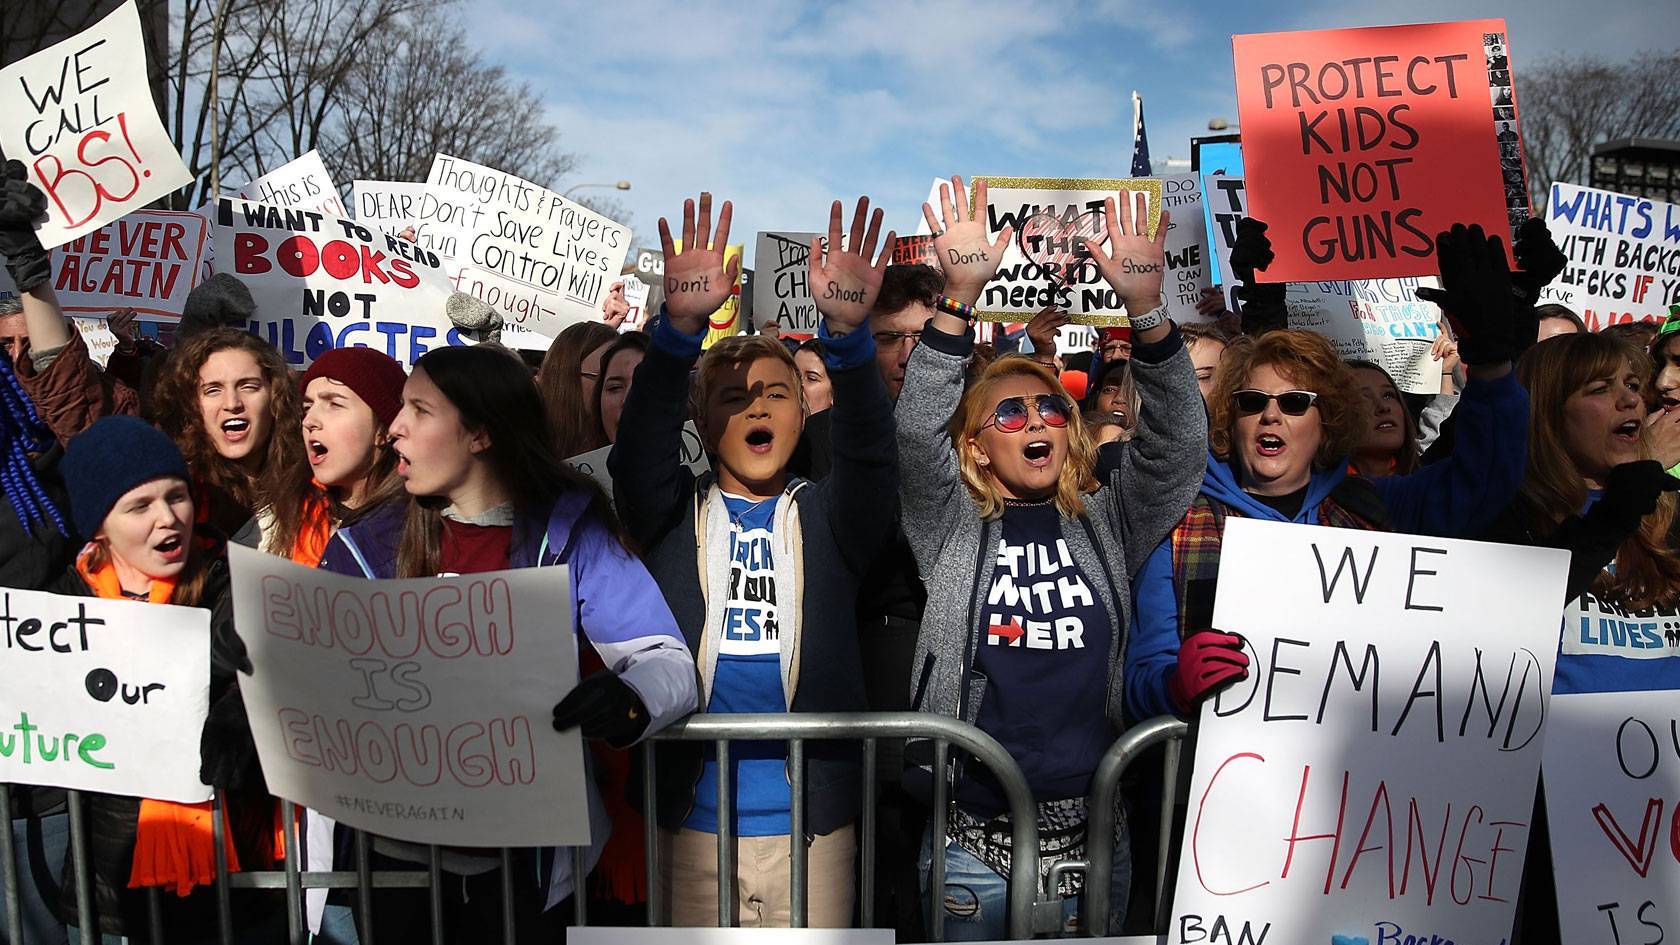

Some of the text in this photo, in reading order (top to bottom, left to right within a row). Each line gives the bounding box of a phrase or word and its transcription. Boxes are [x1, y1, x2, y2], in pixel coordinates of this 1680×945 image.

[20, 38, 110, 114] WE
[1261, 54, 1468, 108] PROTECT
[25, 94, 114, 156] CALL
[1299, 104, 1419, 155] KIDS
[33, 112, 151, 229] BS!
[261, 174, 321, 206] this is
[1166, 179, 1195, 193] DO
[1318, 157, 1413, 204] NOT
[362, 192, 415, 219] DEAR
[438, 157, 534, 212] Thoughts
[549, 197, 622, 249] Prayers
[987, 200, 1106, 233] WHAT
[1162, 192, 1202, 208] THIS?
[1552, 184, 1653, 239] WHAT'S
[218, 197, 234, 227] I
[241, 202, 323, 233] WANT
[337, 219, 372, 243] TO
[384, 234, 440, 268] READ
[420, 193, 610, 272] Don't Save Lives
[1027, 234, 1093, 259] THE
[1302, 208, 1434, 264] GUNS
[55, 255, 181, 300] AGAIN
[234, 232, 420, 289] BOOKS
[416, 223, 603, 305] Gun Control Will
[948, 248, 990, 266] Don't
[1122, 260, 1162, 275] Shoot
[1165, 244, 1200, 270] WE
[1177, 268, 1202, 282] CAN
[1615, 239, 1680, 277] BACKG
[302, 288, 376, 318] NOT
[668, 275, 710, 294] Don't
[823, 280, 867, 304] Shoot
[1178, 282, 1196, 293] DO
[1632, 274, 1654, 304] IF
[988, 574, 1094, 614] WITH
[1311, 543, 1447, 612] WE
[0, 592, 105, 653] tect
[261, 575, 514, 660] ENOUGH
[988, 613, 1085, 650] HER
[1581, 616, 1664, 649] LIVES
[85, 667, 166, 705] Our
[350, 658, 431, 712] IS
[1214, 633, 1544, 752] DEMAND
[278, 706, 535, 789] ENOUGH
[335, 794, 465, 821] #NEVERAGAIN
[1193, 752, 1527, 906] CHANGE
